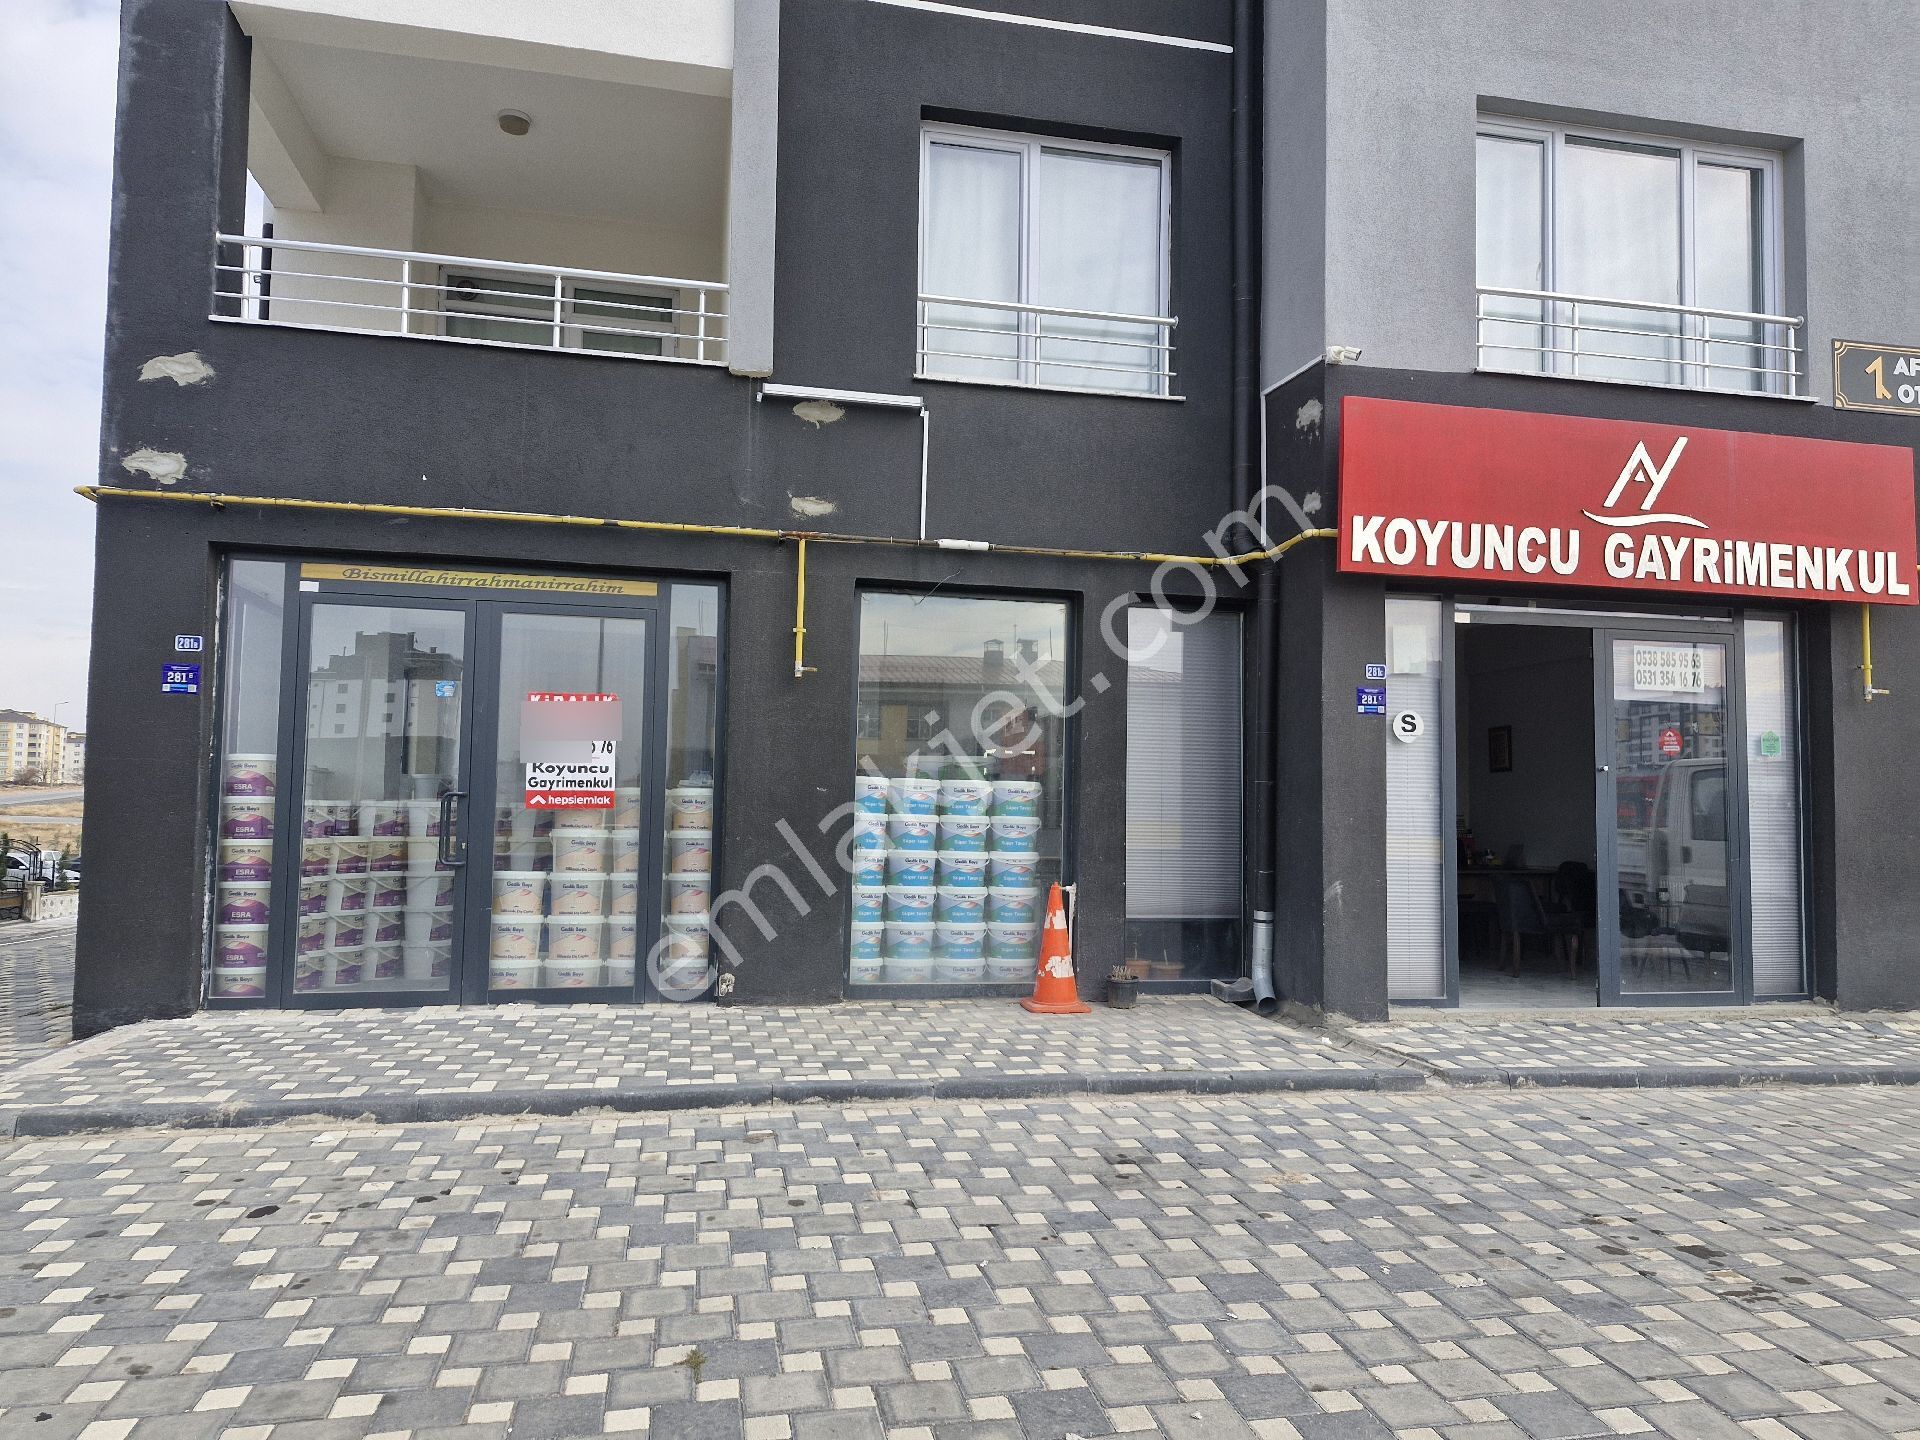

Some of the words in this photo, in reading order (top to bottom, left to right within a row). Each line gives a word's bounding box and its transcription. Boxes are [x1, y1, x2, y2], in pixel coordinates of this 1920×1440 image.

[1351, 515, 1581, 576] KOYUNCU
[342, 567, 625, 594] Bismillahirrahmanirrahim
[1635, 649, 1658, 668] 0538
[1660, 650, 1677, 668] 585
[1679, 652, 1689, 669] 95
[1691, 653, 1702, 670] 63
[167, 671, 188, 683] 281
[1635, 669, 1657, 686] 0531
[1660, 670, 1676, 687] 354
[1680, 672, 1688, 688] 16
[1691, 672, 1702, 688] 76
[1361, 694, 1378, 704] 281
[1401, 713, 1417, 733] S
[532, 763, 610, 777] Koyuncu
[527, 776, 613, 791] Gayrimenkul
[548, 794, 611, 806] hepsiemlak
